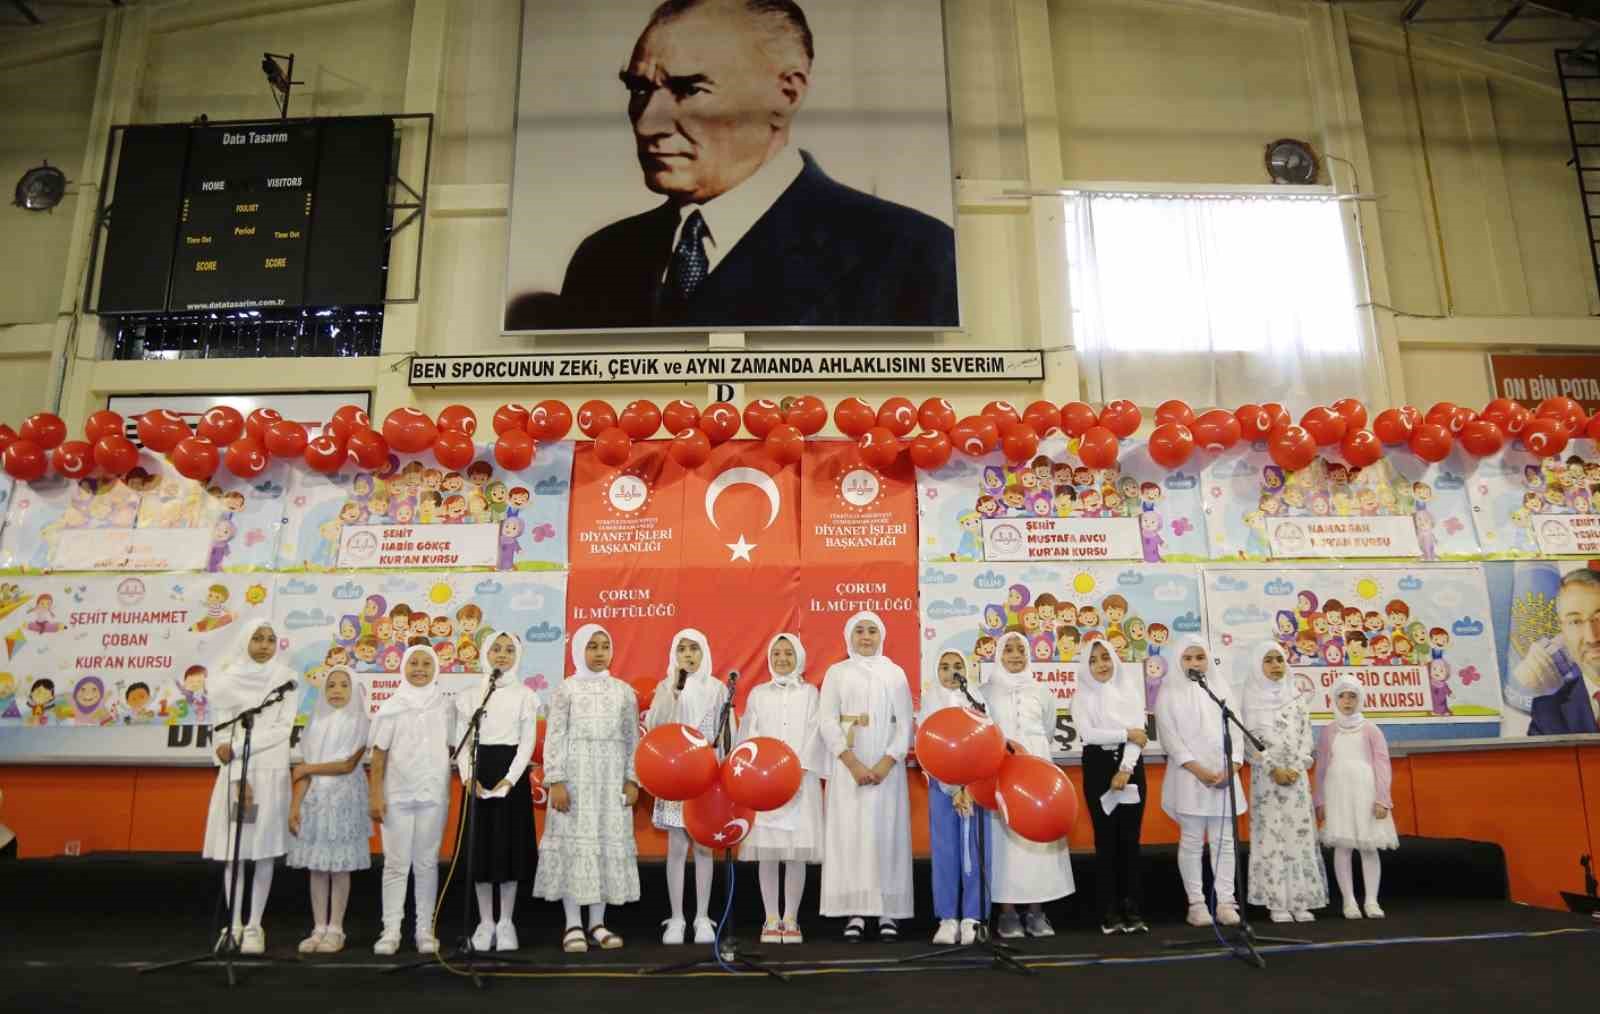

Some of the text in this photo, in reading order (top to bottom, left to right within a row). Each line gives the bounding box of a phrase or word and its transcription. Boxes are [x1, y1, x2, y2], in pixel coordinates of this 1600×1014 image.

[202, 181, 225, 192] HOME
[267, 177, 303, 188] VISITORS
[234, 226, 256, 236] Period
[195, 261, 217, 271] SCORE
[265, 258, 287, 269] SCORE
[413, 362, 447, 378] BEN
[451, 360, 555, 378] SPORCUNUN
[664, 360, 682, 375] ve
[687, 358, 725, 374] AYNI
[731, 358, 813, 374] ZAMANDA
[819, 357, 925, 374] AHLAKLISINI
[1503, 378, 1528, 400] ON
[579, 528, 672, 543] DİYANET İŞLERİ
[815, 523, 907, 536] DİYANET İŞLERİ
[825, 536, 897, 549] BAŞKANLIĞI
[1027, 533, 1077, 543] MUSTAFA
[591, 541, 662, 555] BAŞKANLIĞI
[1029, 546, 1109, 557] KUR'AN KURSU
[379, 554, 459, 565] KUR'AN KURSU
[599, 589, 650, 603] ÇORUM
[835, 583, 887, 596] ÇORUM
[70, 609, 188, 627] ŞEHİT MUHAMMET
[102, 633, 149, 650] ÇOBAN
[75, 655, 172, 670] KUR'AN KURSU
[1032, 669, 1076, 686] Z.AİŞE
[1379, 692, 1425, 708] KURSU
